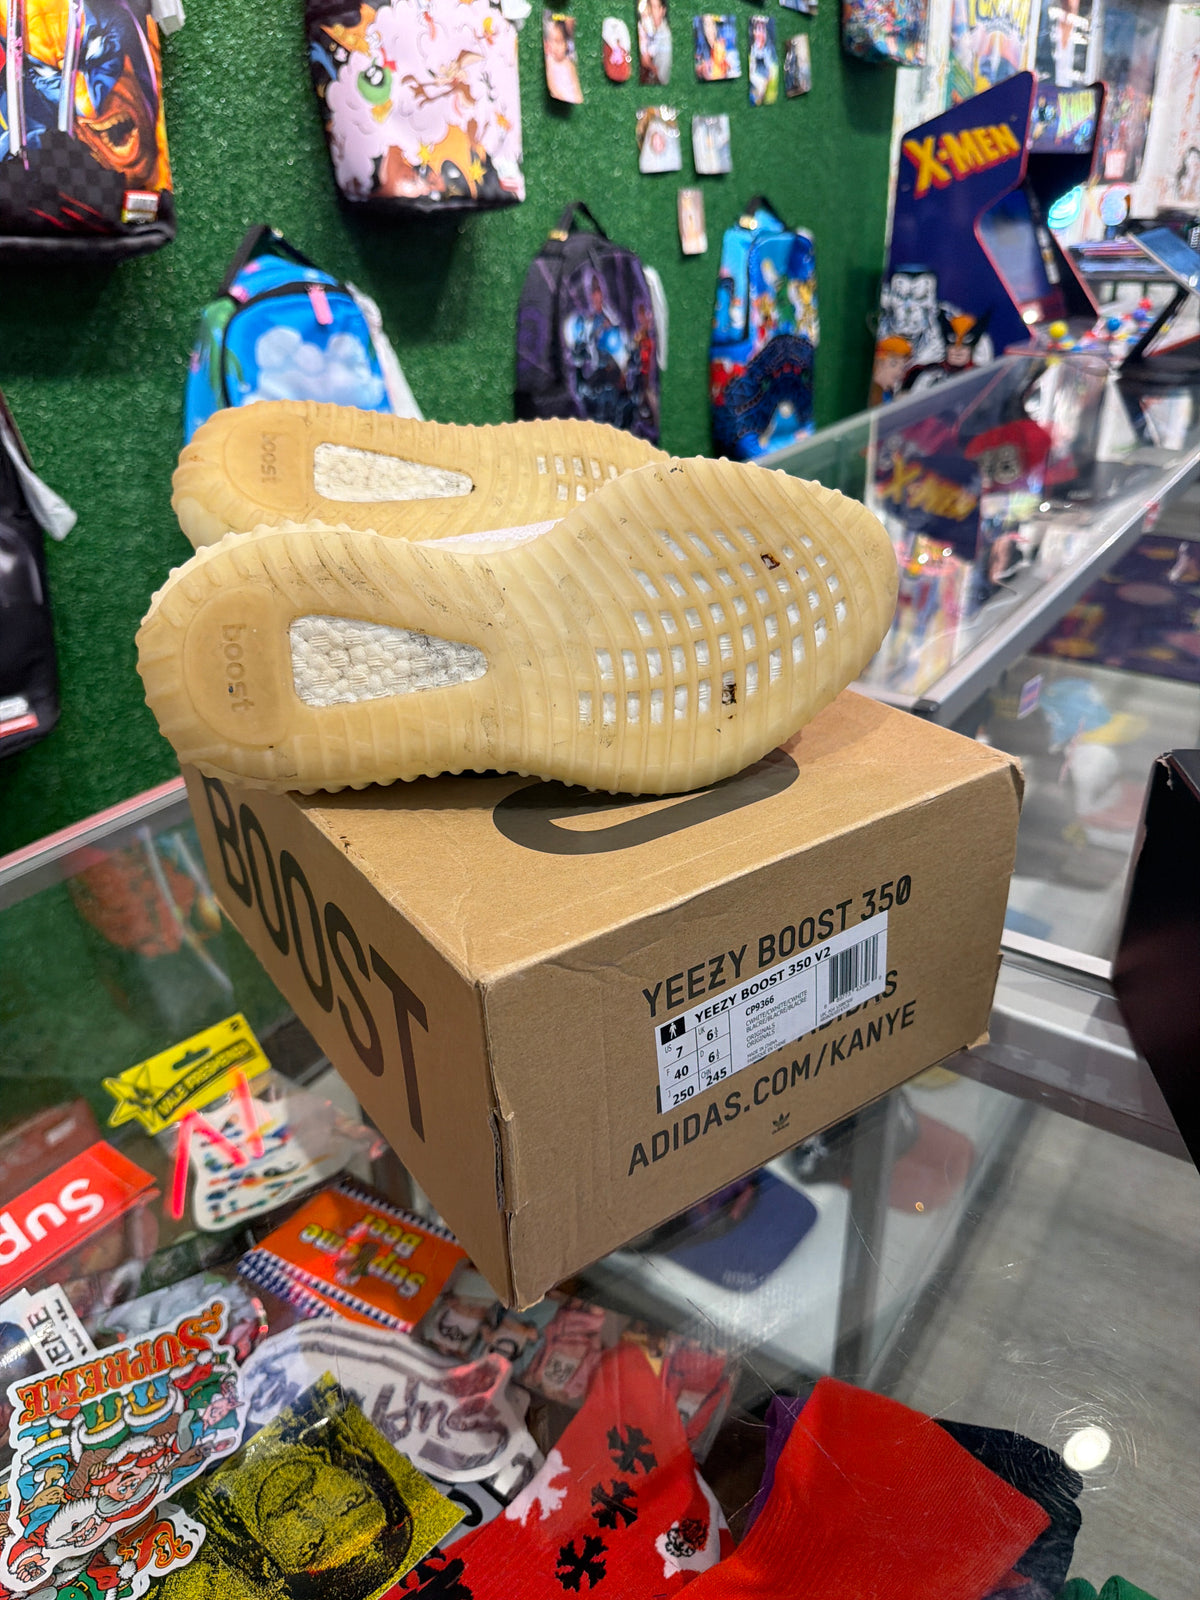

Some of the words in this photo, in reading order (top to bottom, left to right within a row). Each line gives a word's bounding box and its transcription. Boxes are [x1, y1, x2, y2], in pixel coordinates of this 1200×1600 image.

[903, 122, 1020, 200] X-MEN
[221, 624, 254, 713] boost
[642, 944, 748, 1018] YEEZY
[758, 898, 853, 969] BOOST
[860, 875, 912, 921] 350
[202, 776, 429, 1143] BOOST
[694, 993, 737, 1023] YEEZY
[740, 969, 785, 1001] BOOST
[788, 956, 812, 977] 350
[814, 946, 831, 963] V2
[745, 995, 775, 1016] CP9366
[698, 1025, 706, 1036] UK
[746, 1023, 775, 1043] ORIGINALS
[746, 1030, 775, 1049] ORIGINALS
[664, 1042, 672, 1054] US
[675, 1045, 684, 1059] 7
[674, 1064, 689, 1081] 40
[706, 1067, 727, 1087] 245
[627, 999, 917, 1177] ADIDAS.COM/KANYE
[672, 1084, 695, 1106] 250
[17, 1302, 225, 1426] SUPREME
